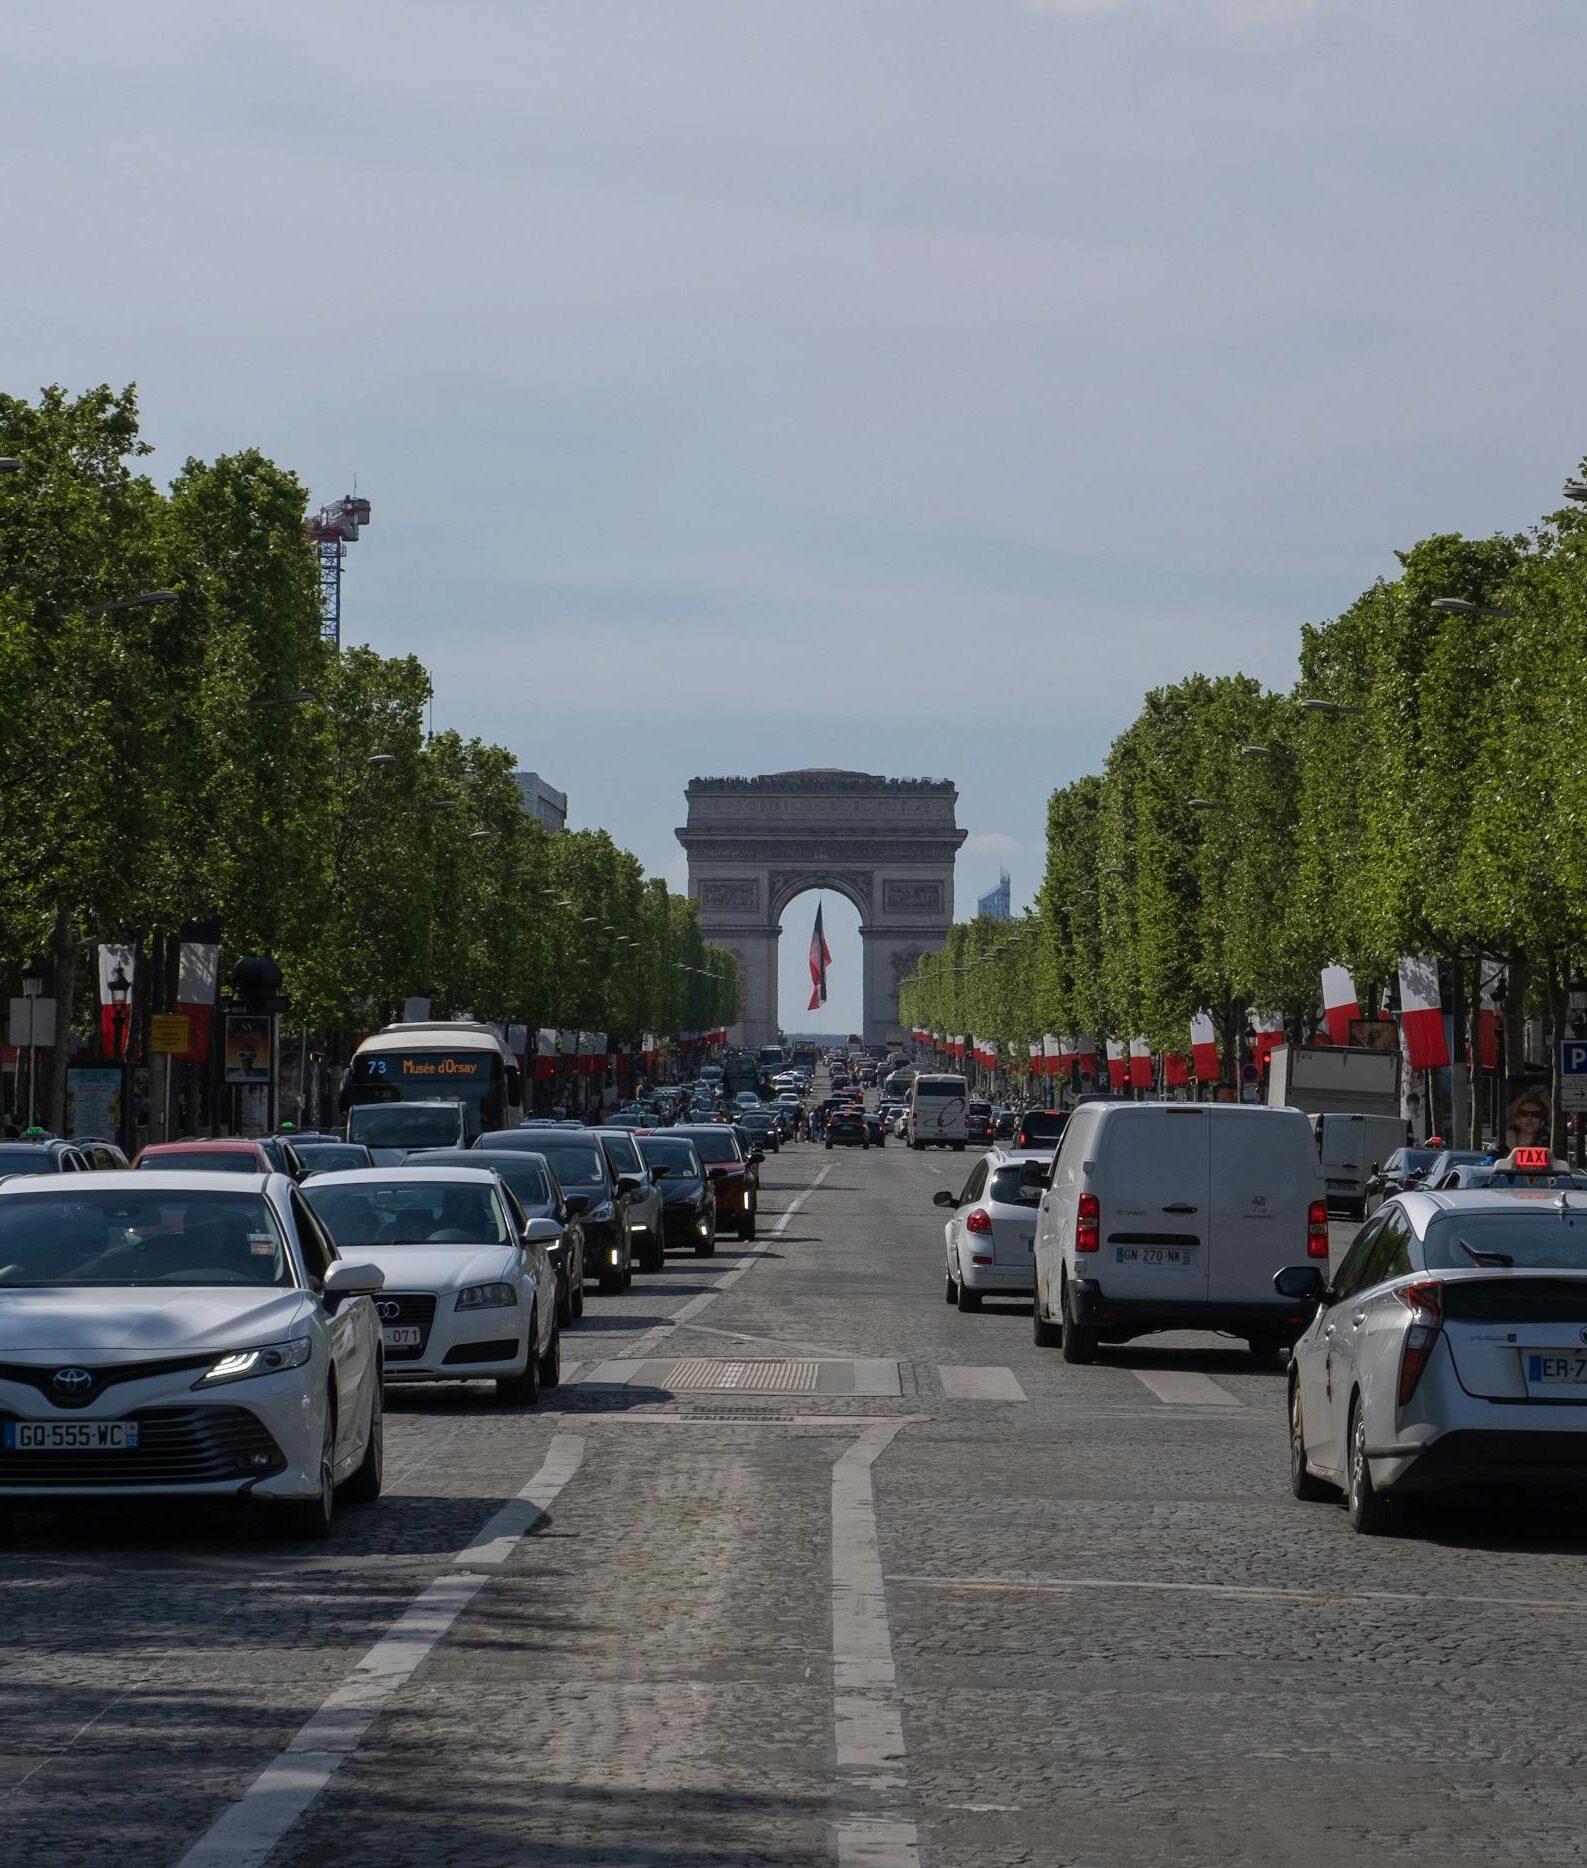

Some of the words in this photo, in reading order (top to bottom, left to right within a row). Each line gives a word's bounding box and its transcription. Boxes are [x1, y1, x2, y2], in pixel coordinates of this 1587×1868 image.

[367, 1060, 387, 1075] 73
[402, 1059, 436, 1075] Musée
[1571, 1047, 1587, 1070] P
[1517, 1149, 1548, 1163] TAXI
[20, 1424, 122, 1446] GQ-555-WC
